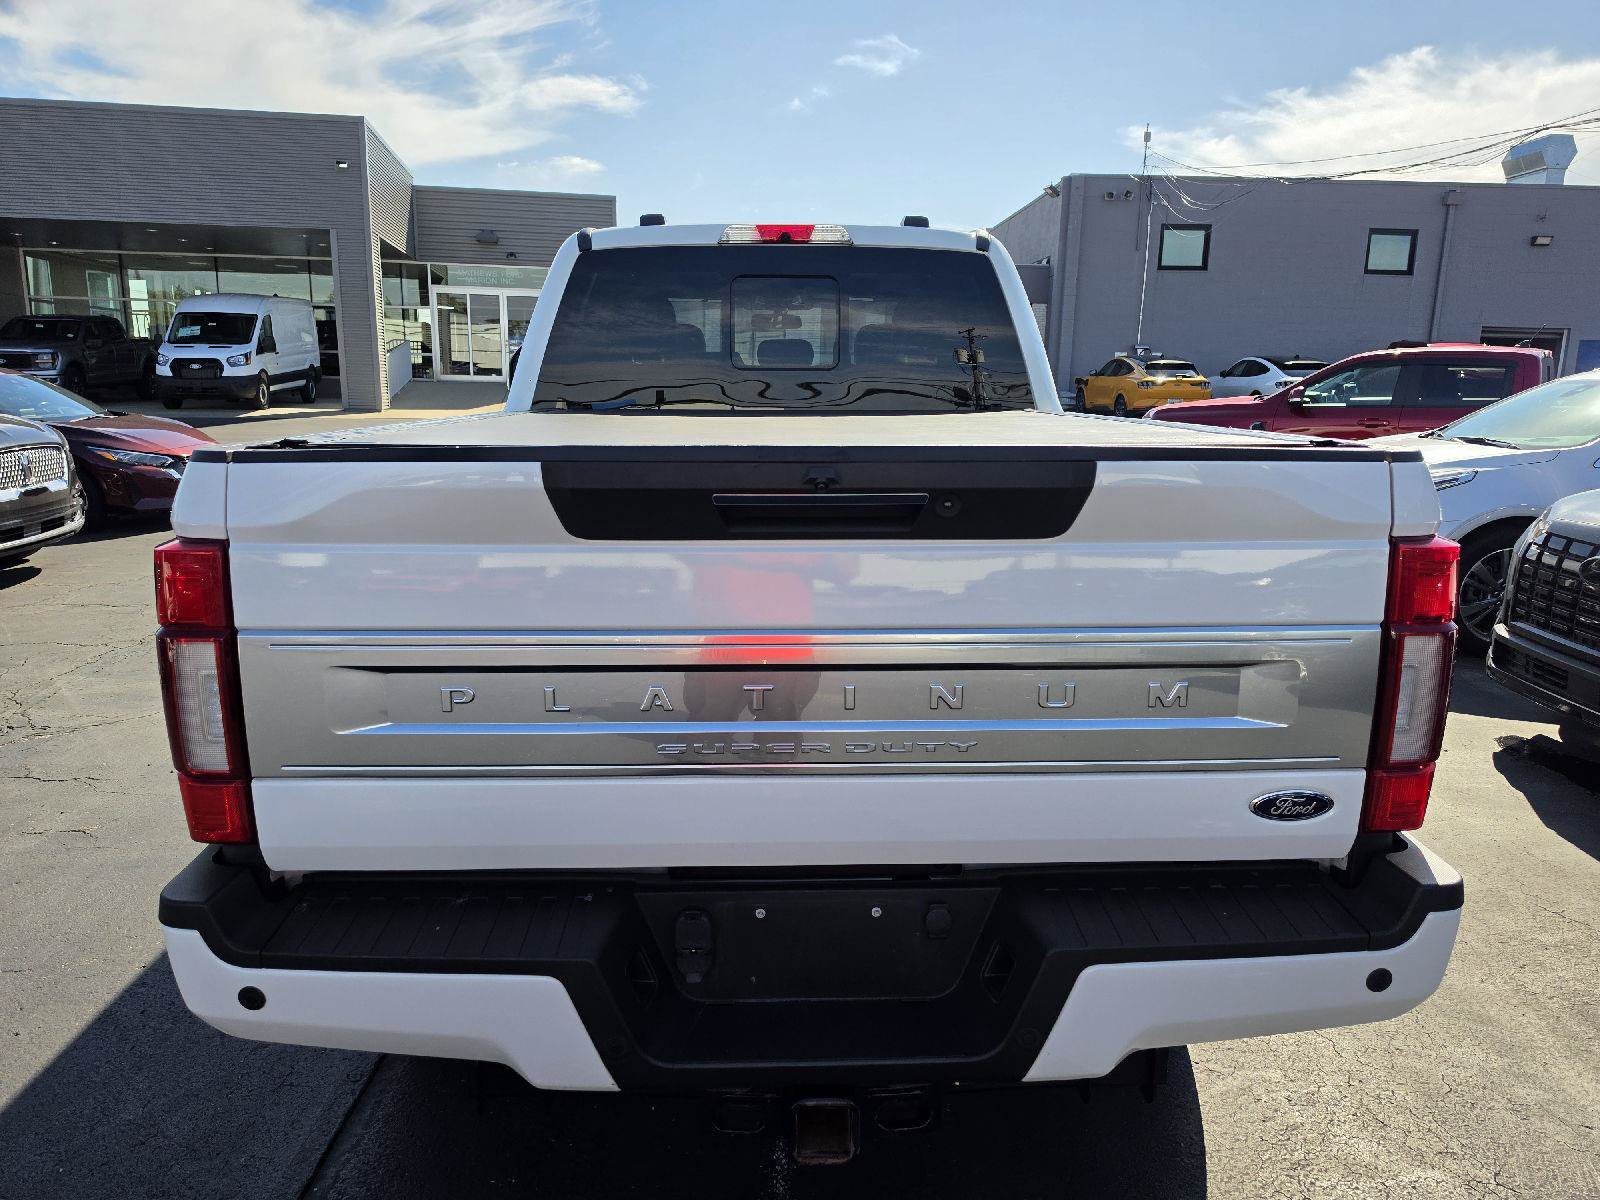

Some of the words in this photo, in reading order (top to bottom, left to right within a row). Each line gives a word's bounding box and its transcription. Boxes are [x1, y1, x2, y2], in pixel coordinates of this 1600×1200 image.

[440, 682, 1188, 713] PLATINUM
[656, 742, 831, 754] SUPER
[845, 740, 978, 754] DUTY
[1270, 797, 1317, 815] Ford
